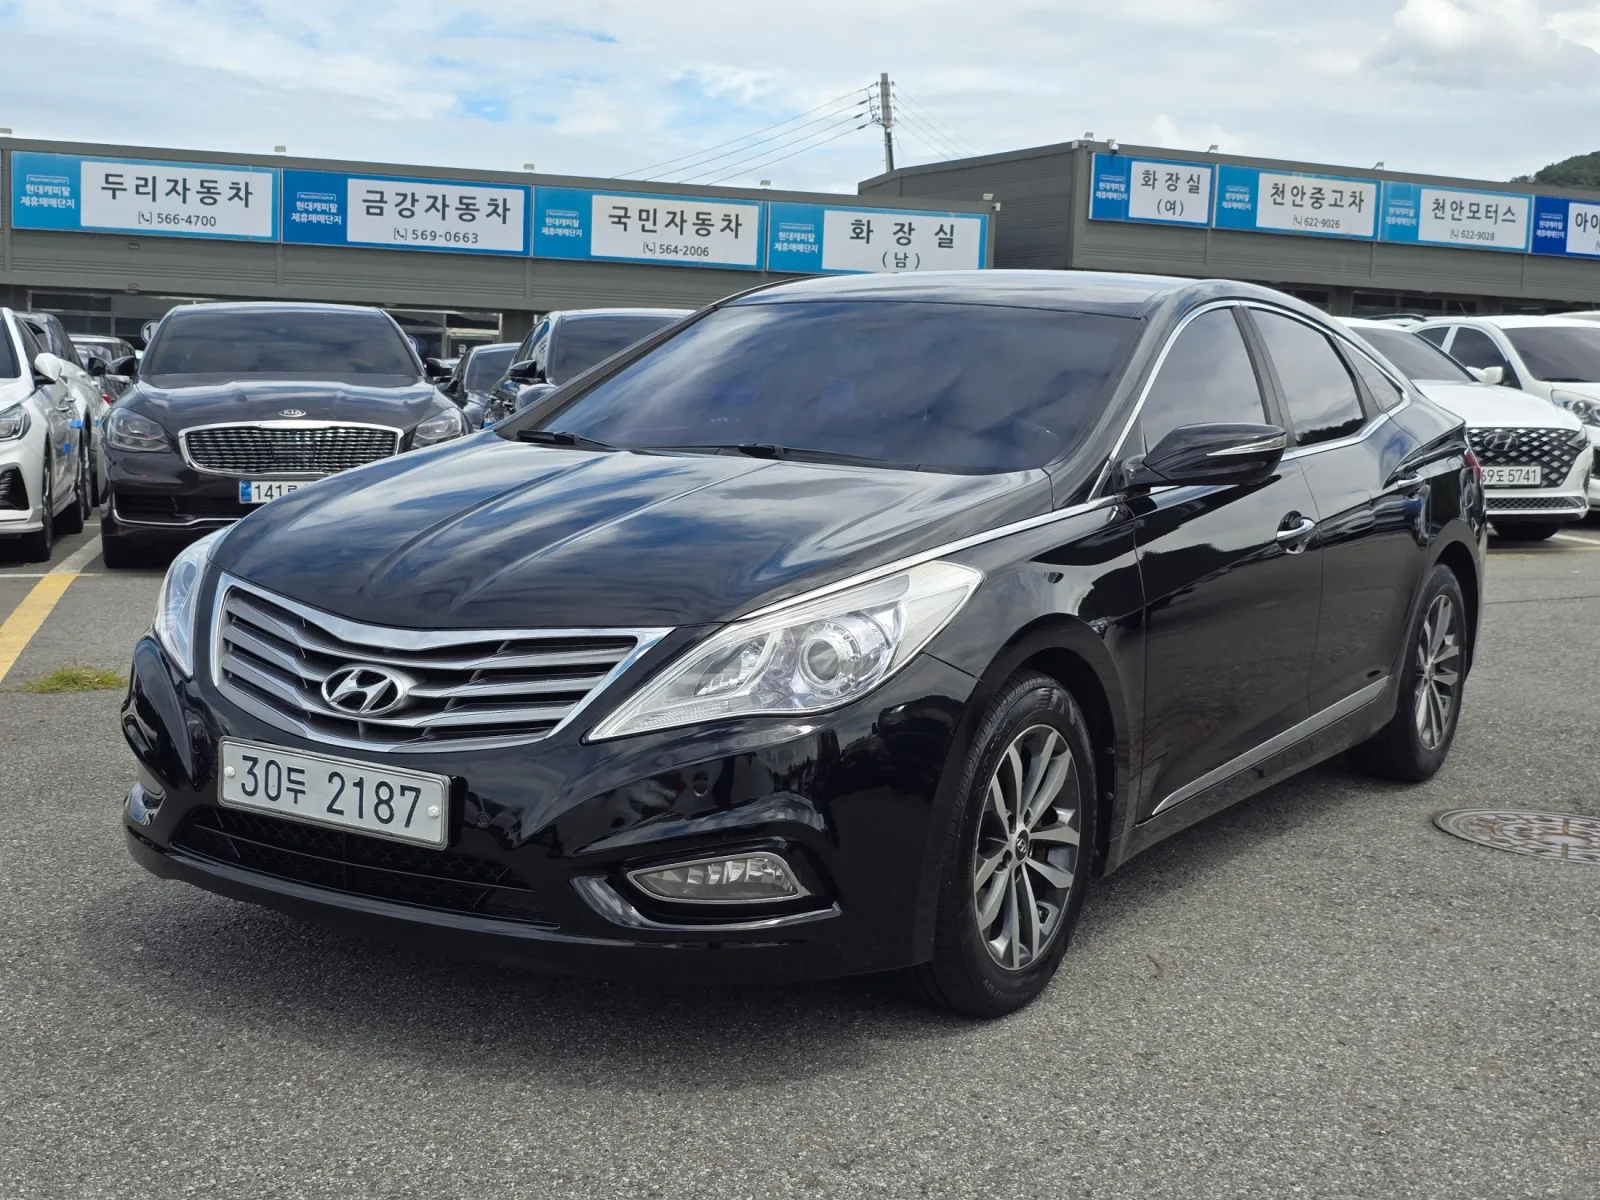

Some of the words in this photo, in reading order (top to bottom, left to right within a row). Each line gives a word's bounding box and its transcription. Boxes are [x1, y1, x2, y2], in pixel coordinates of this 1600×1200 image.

[25, 183, 71, 197] 현대캐피탈
[101, 173, 253, 208] 두리자동차
[1270, 182, 1364, 213] 천안중고차
[20, 196, 75, 209] 제휴매매단지
[295, 200, 338, 213] 현대캐피탈
[362, 189, 511, 225] 금강자동차
[1157, 198, 1184, 217] (여)
[291, 212, 342, 225] 제휴매매단지
[1431, 197, 1516, 225] 천안모터스
[157, 212, 216, 227] 566-4700
[608, 205, 742, 239] 국민자동차
[1304, 217, 1340, 229] 622-9026
[411, 229, 479, 244] 569-0663
[1460, 229, 1495, 241] 622-9028
[658, 243, 710, 257] 564-2006
[881, 250, 921, 270] (남)
[1507, 468, 1537, 482] 5741
[240, 754, 306, 805] 30두
[326, 770, 421, 829] 2187
